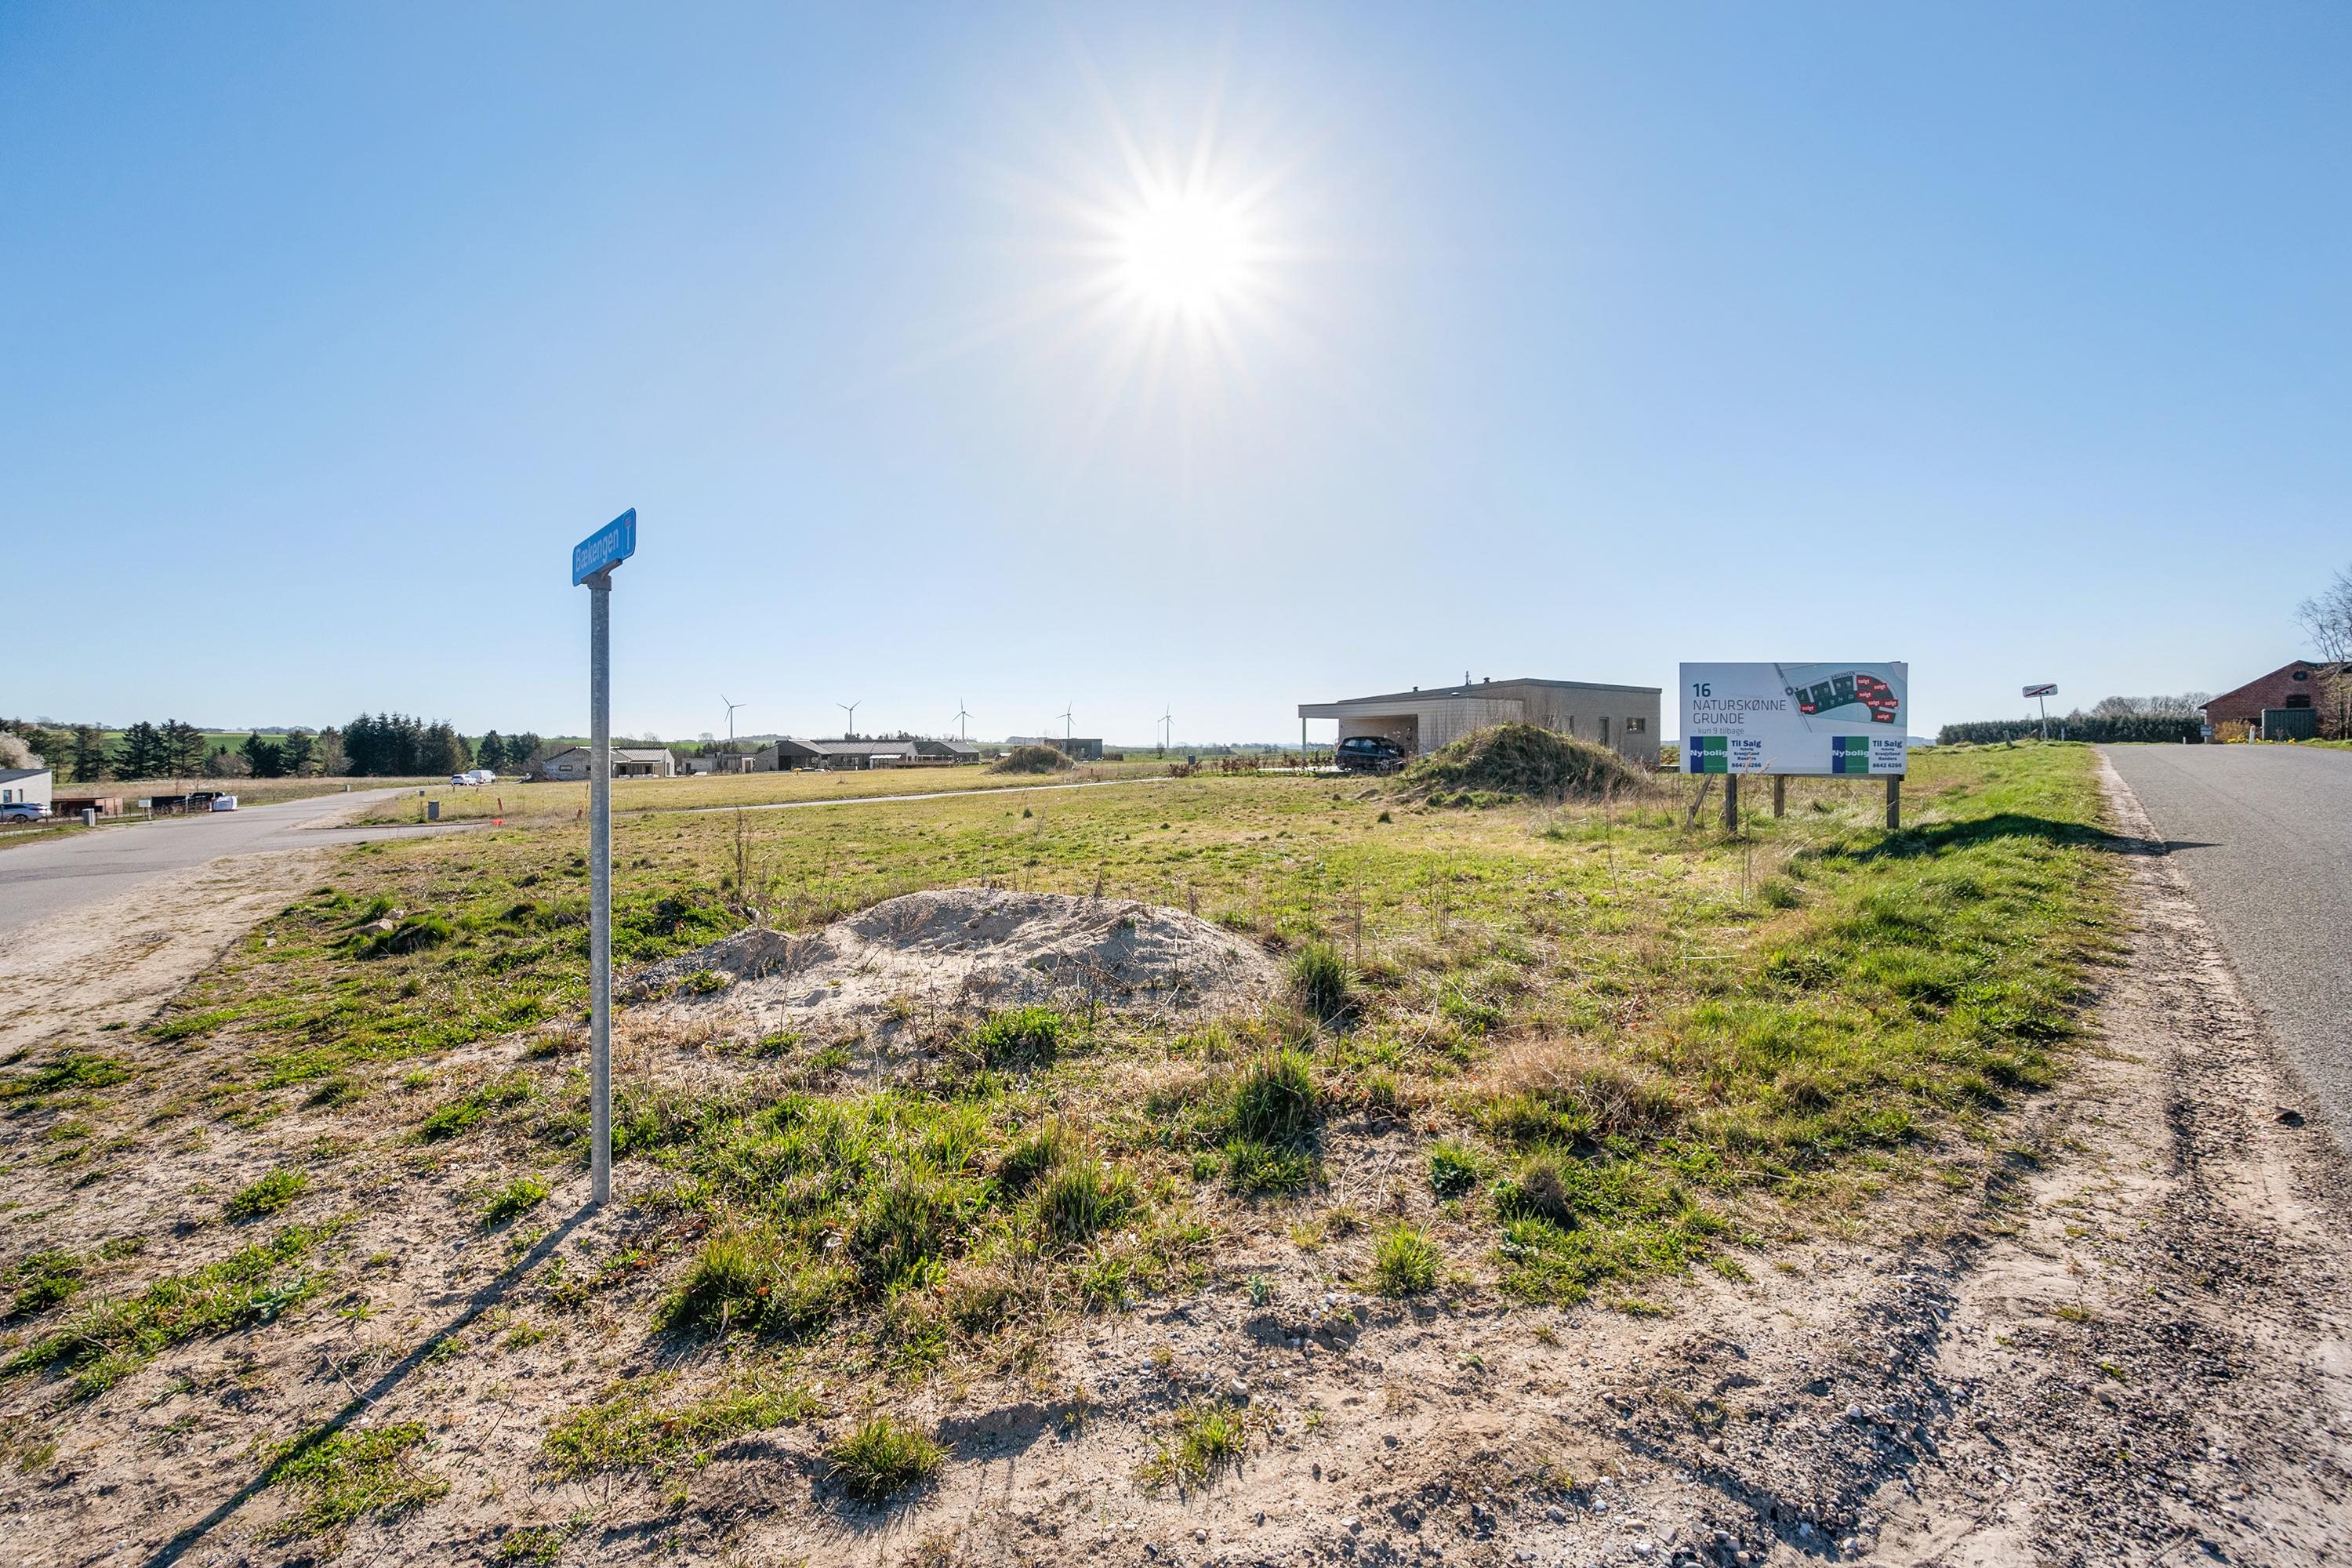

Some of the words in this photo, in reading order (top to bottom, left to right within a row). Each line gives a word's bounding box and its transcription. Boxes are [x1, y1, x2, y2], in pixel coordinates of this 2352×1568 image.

[575, 528, 619, 572] Bækengen
[1693, 683, 1711, 697] 16
[1693, 700, 1787, 710] NATURSKØNNE
[1693, 713, 1744, 724] GRUNDE
[1720, 728, 1744, 736] tilbage
